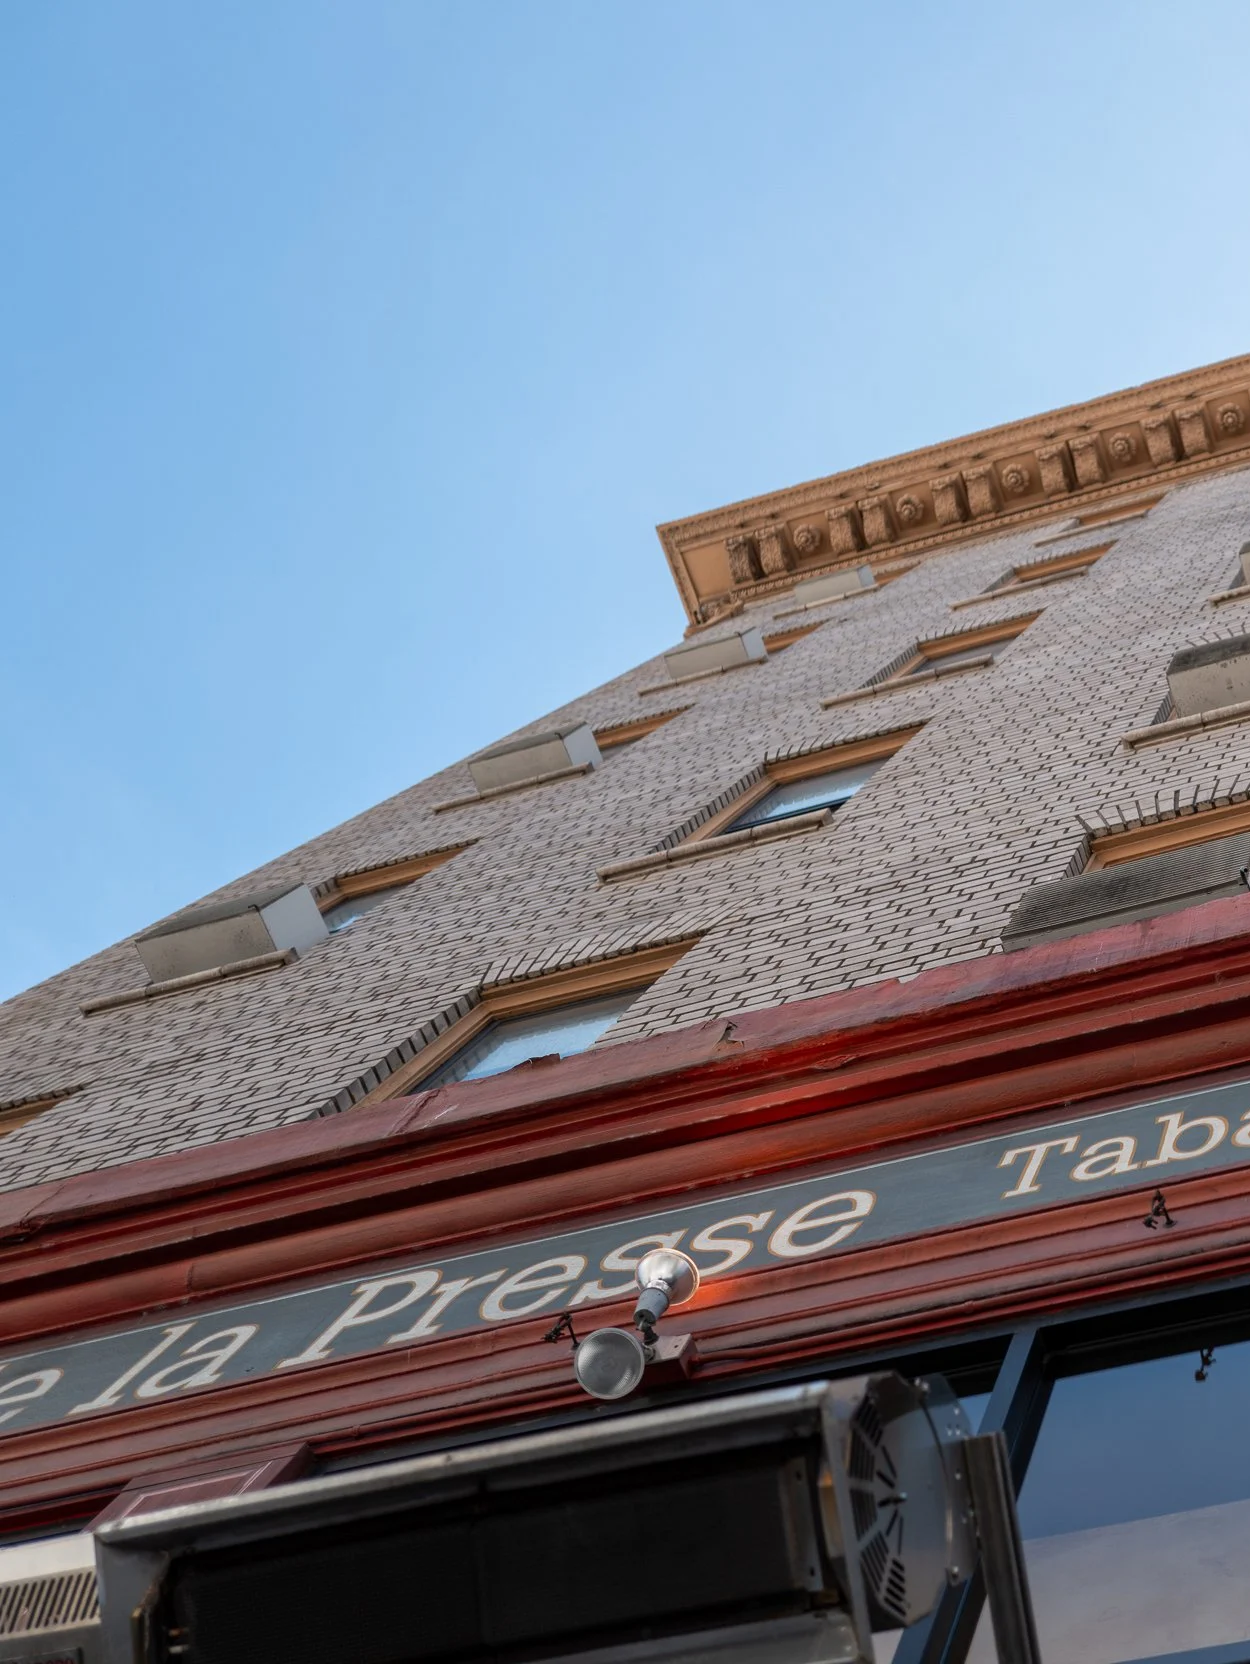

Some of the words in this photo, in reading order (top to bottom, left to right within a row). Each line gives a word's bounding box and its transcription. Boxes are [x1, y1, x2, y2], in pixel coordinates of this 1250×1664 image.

[0, 1363, 65, 1425] e
[64, 1320, 260, 1417] la
[271, 1188, 877, 1370] Presse
